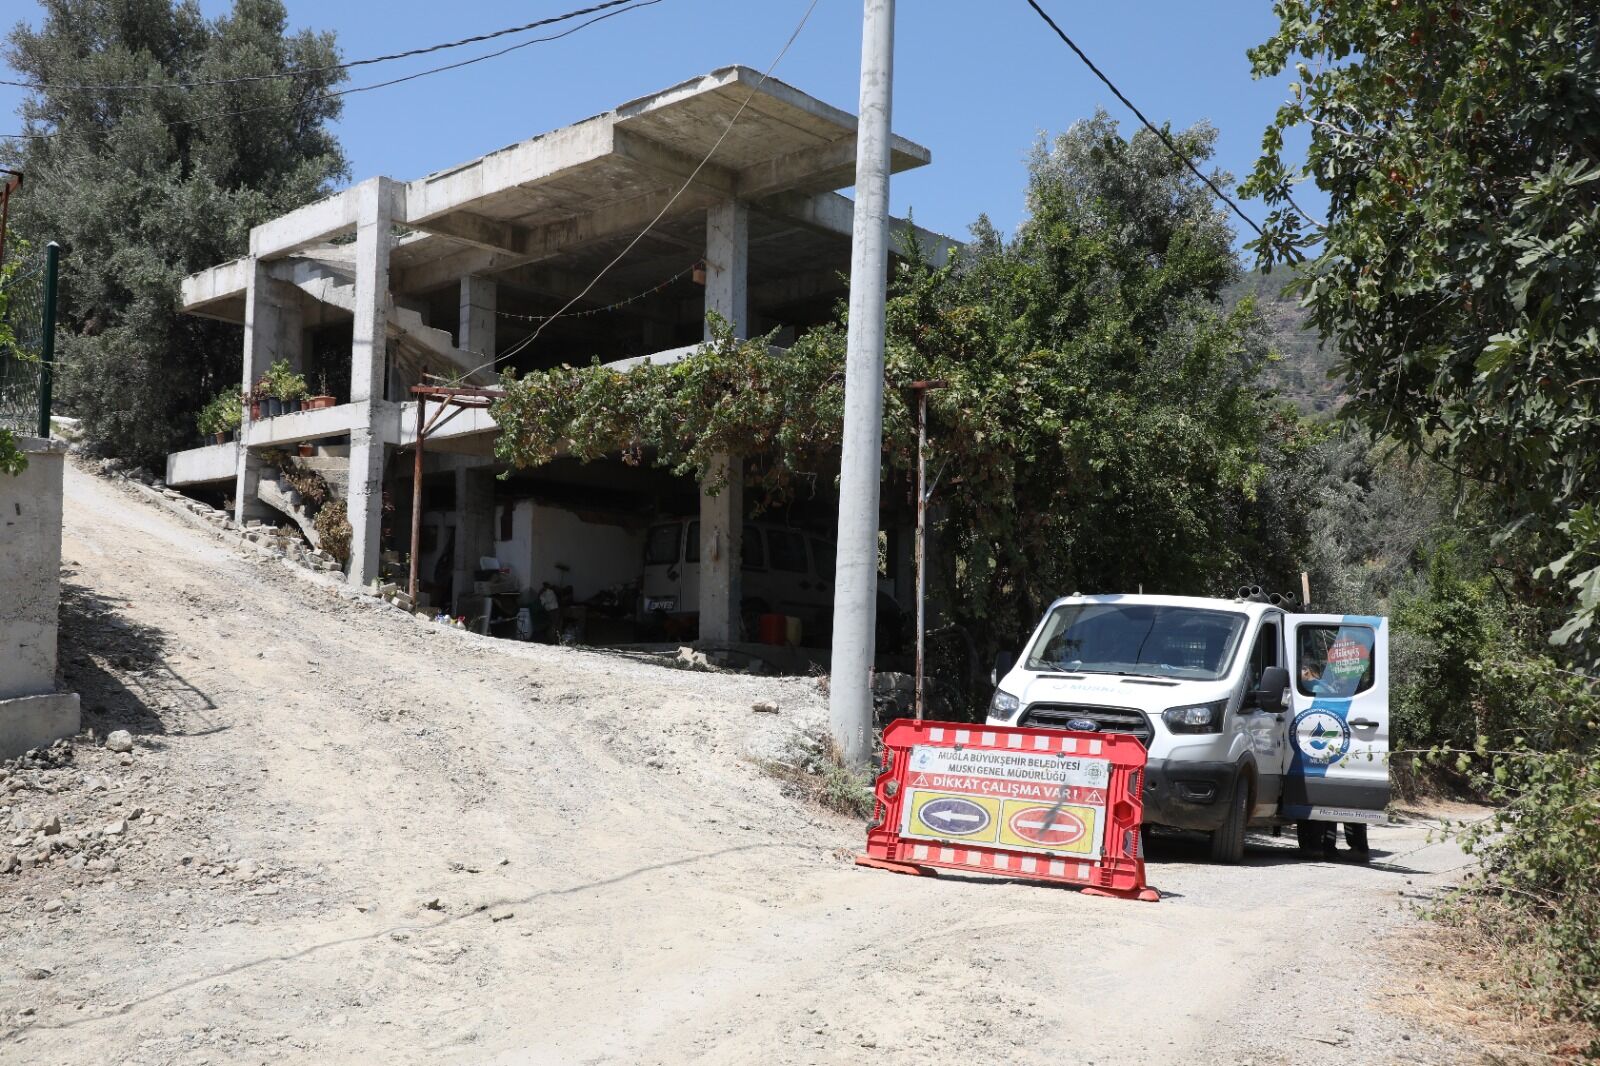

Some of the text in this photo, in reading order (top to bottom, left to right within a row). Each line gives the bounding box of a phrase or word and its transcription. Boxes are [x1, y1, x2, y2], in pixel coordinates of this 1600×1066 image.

[938, 750, 1081, 771] MUĞLA BÜYÜKŞEHİR BELEDİYESİ
[977, 766, 1006, 777] GENEL
[1007, 768, 1067, 782] MÜDÜRLÜĞÜ
[932, 774, 981, 790] DİKKAT
[981, 780, 1041, 798] ÇALIŞMA
